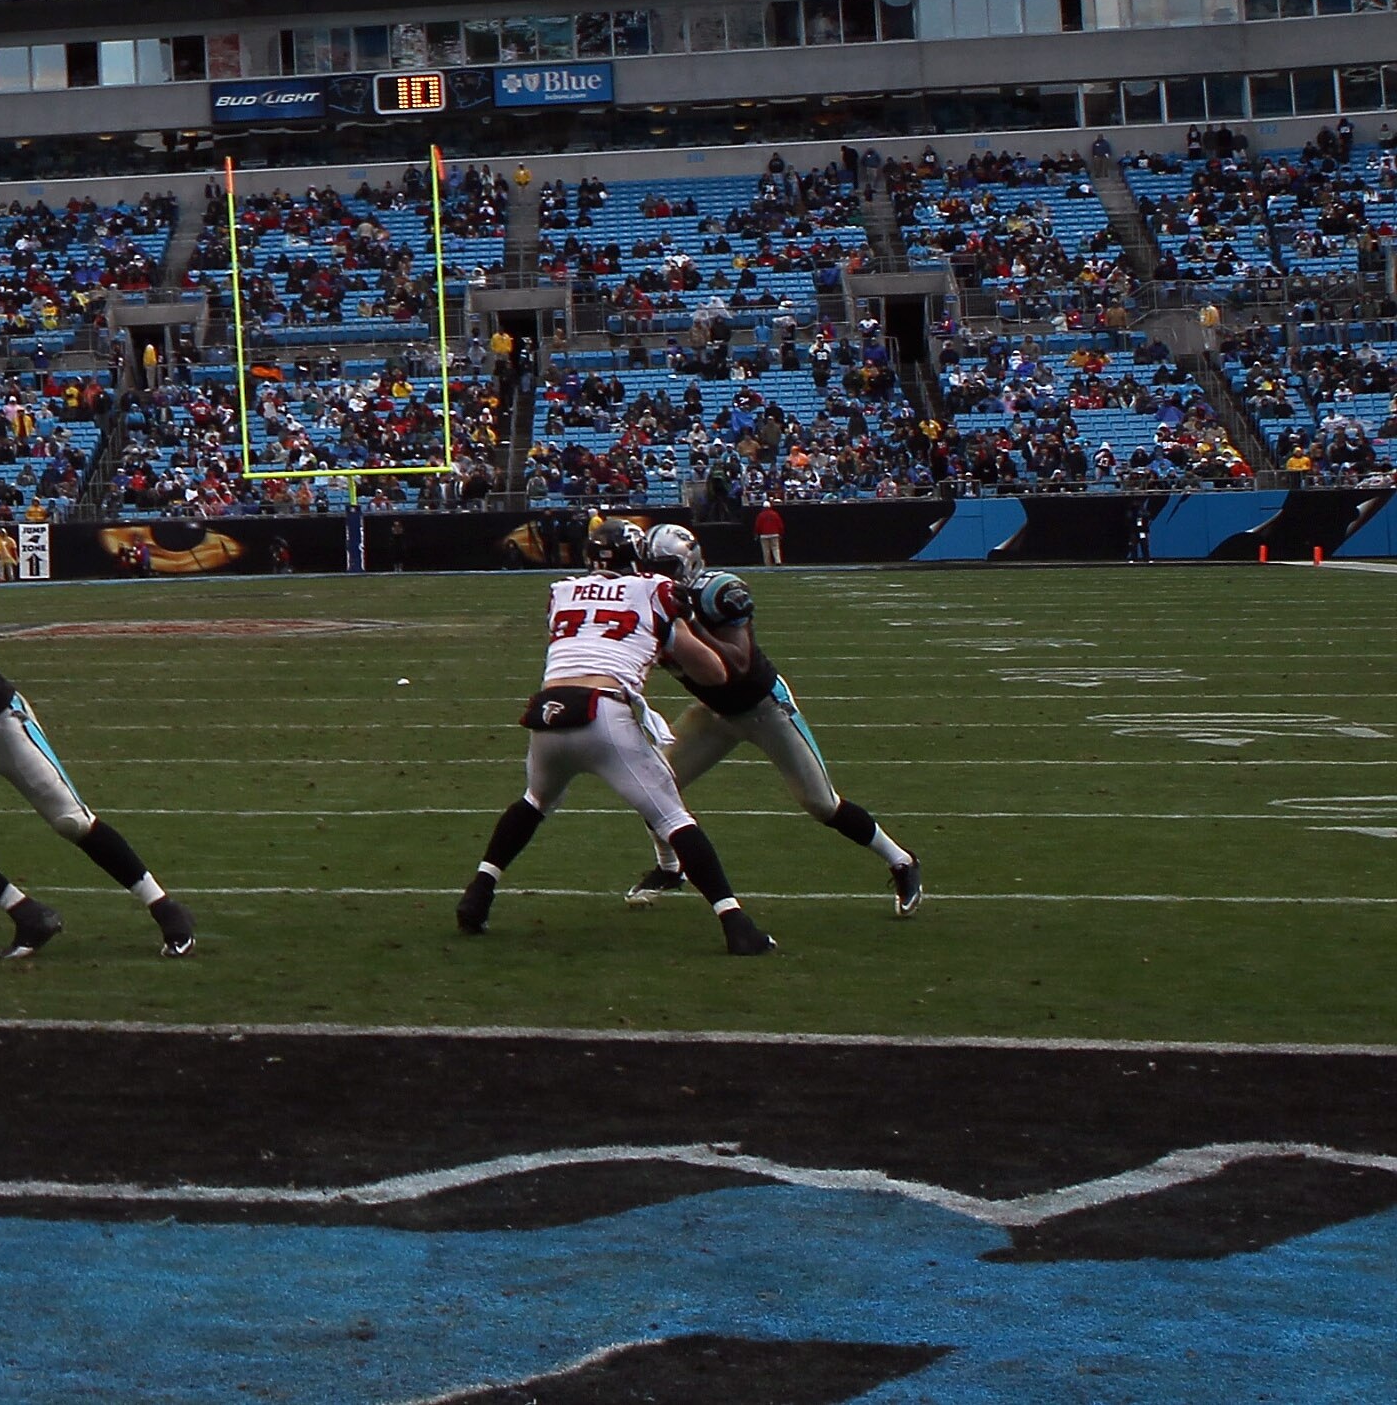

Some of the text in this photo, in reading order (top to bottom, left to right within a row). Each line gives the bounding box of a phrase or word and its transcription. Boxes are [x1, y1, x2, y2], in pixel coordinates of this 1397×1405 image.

[543, 71, 603, 92] Blue
[215, 90, 320, 108] BUD LIGHT
[397, 76, 440, 109] 10
[572, 583, 626, 602] PEELLE
